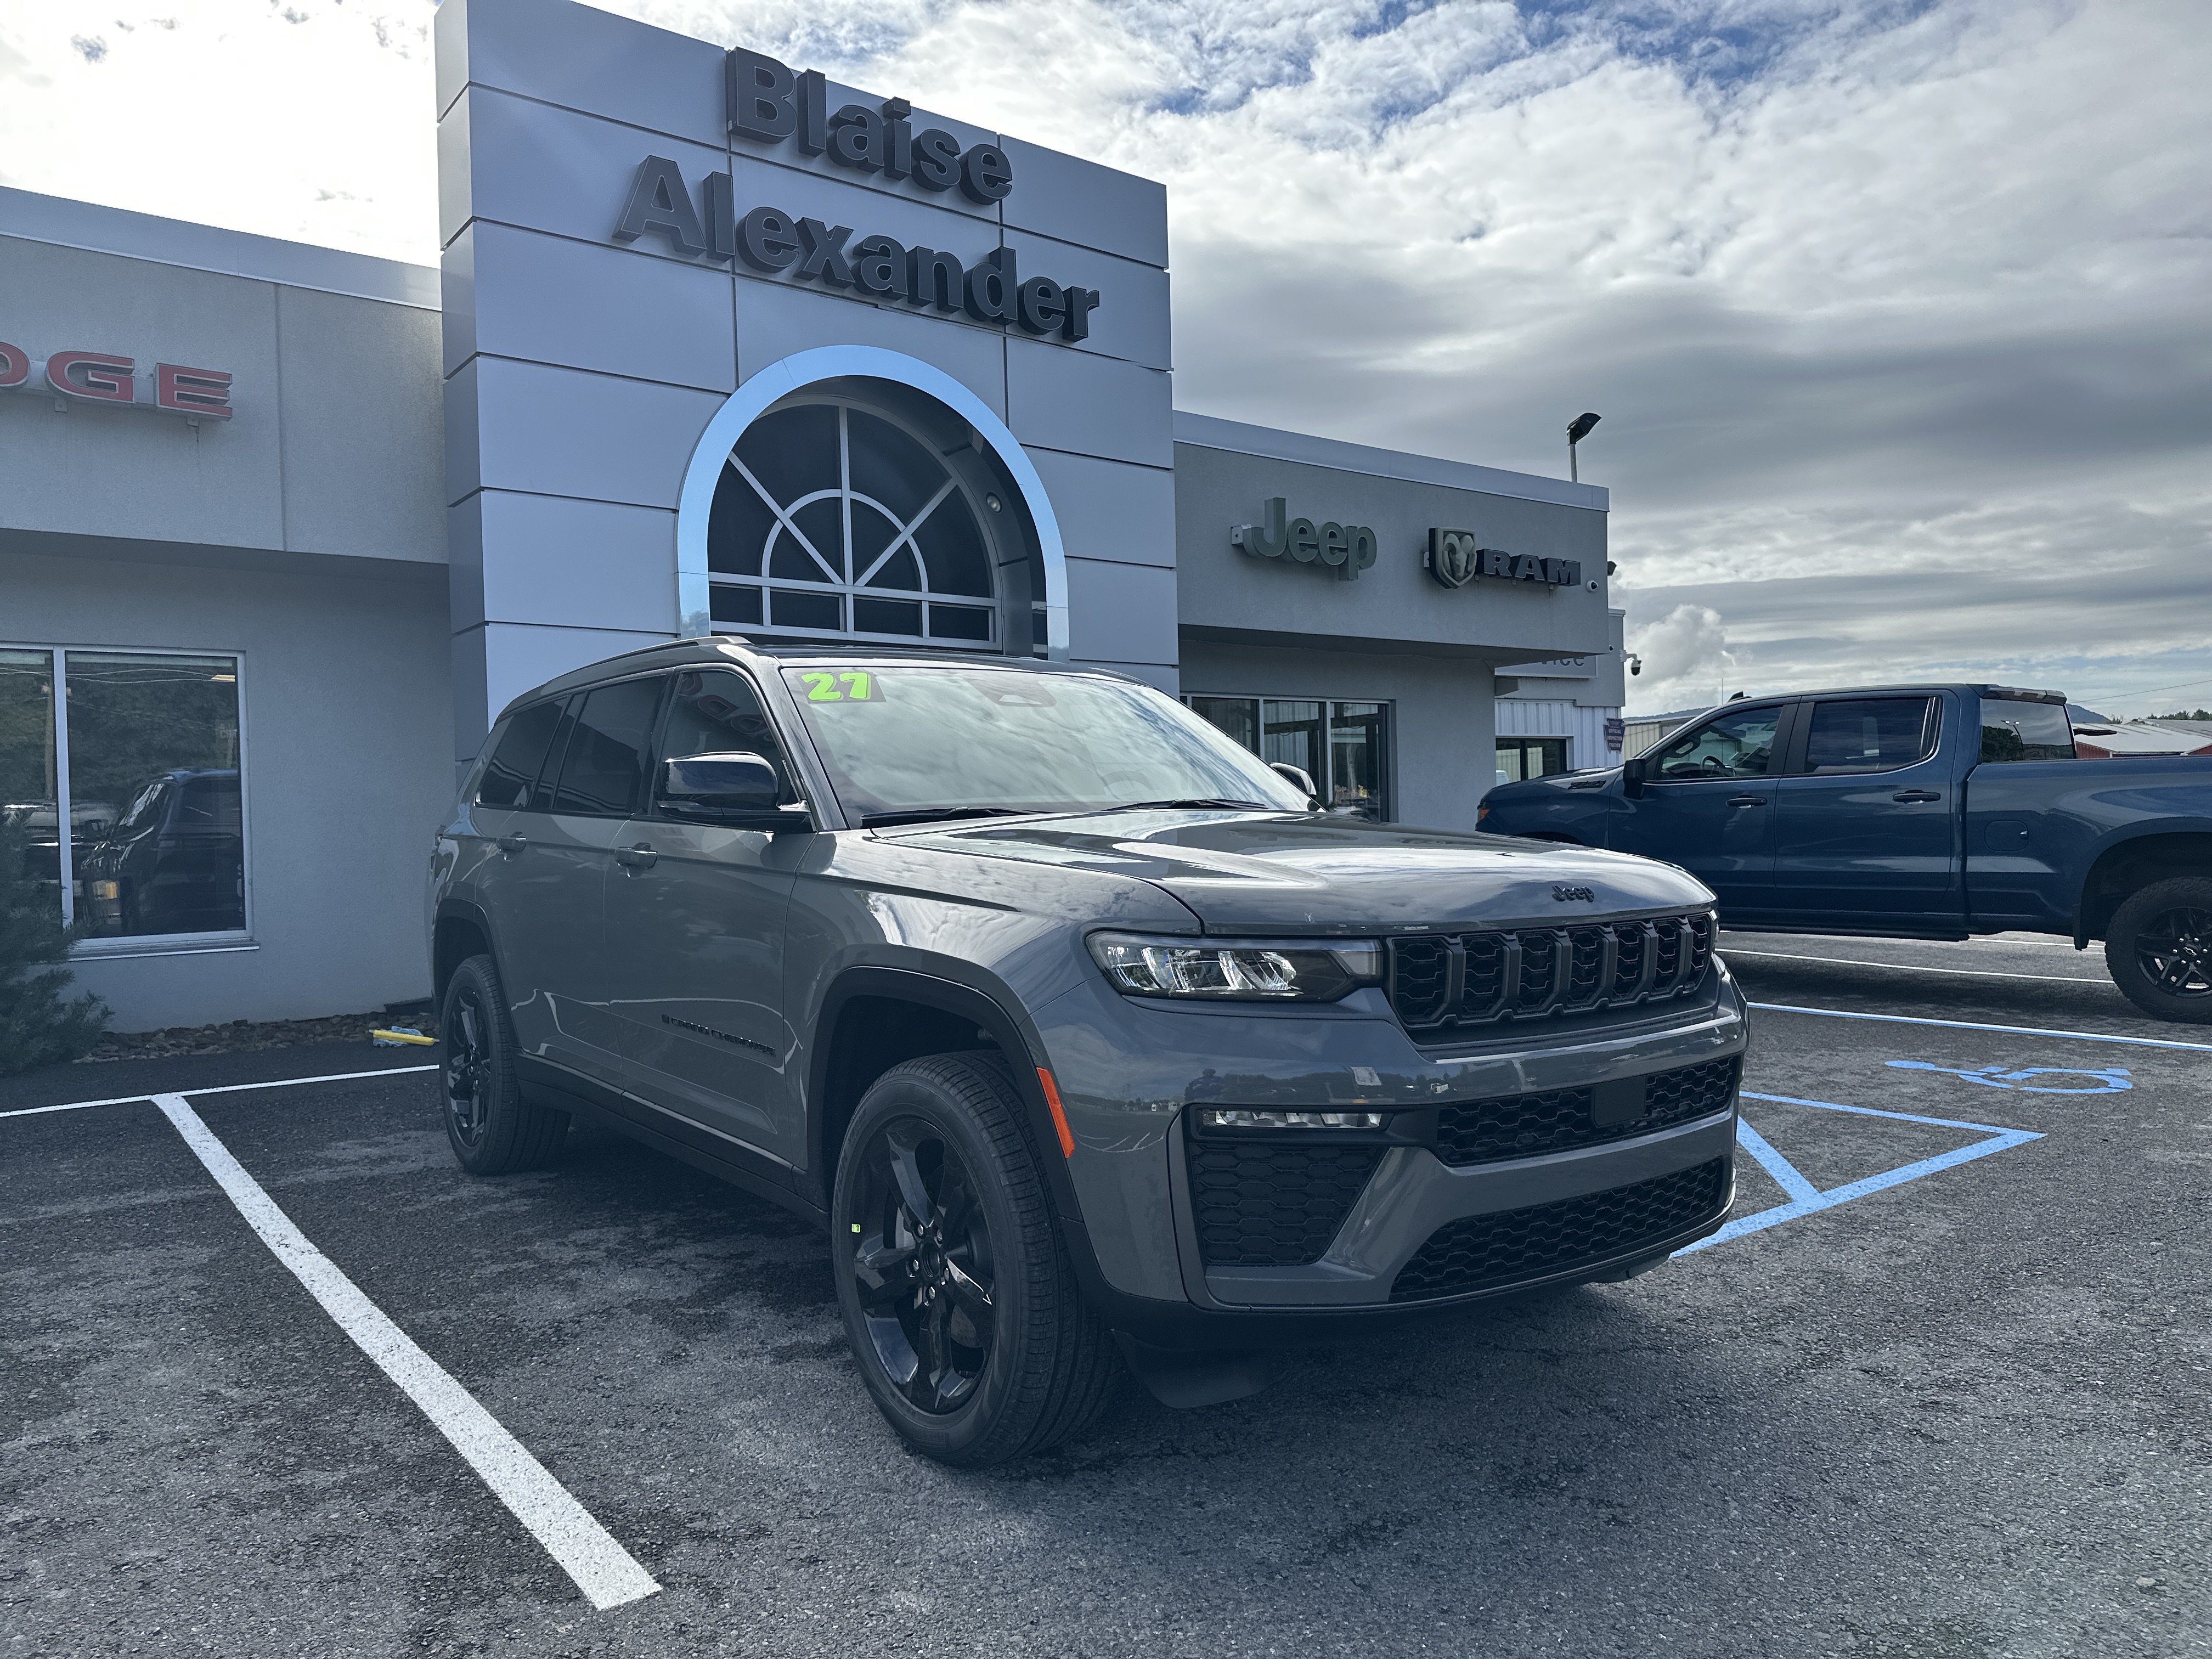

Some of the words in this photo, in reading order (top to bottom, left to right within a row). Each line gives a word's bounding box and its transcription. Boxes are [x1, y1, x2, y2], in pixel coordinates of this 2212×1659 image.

[726, 46, 1013, 205] Blaise
[612, 155, 1099, 342] Alexander
[1243, 497, 1377, 580] Jeep
[1476, 549, 1581, 586] RAM
[801, 672, 871, 701] 27
[1551, 885, 1594, 903] Jeep
